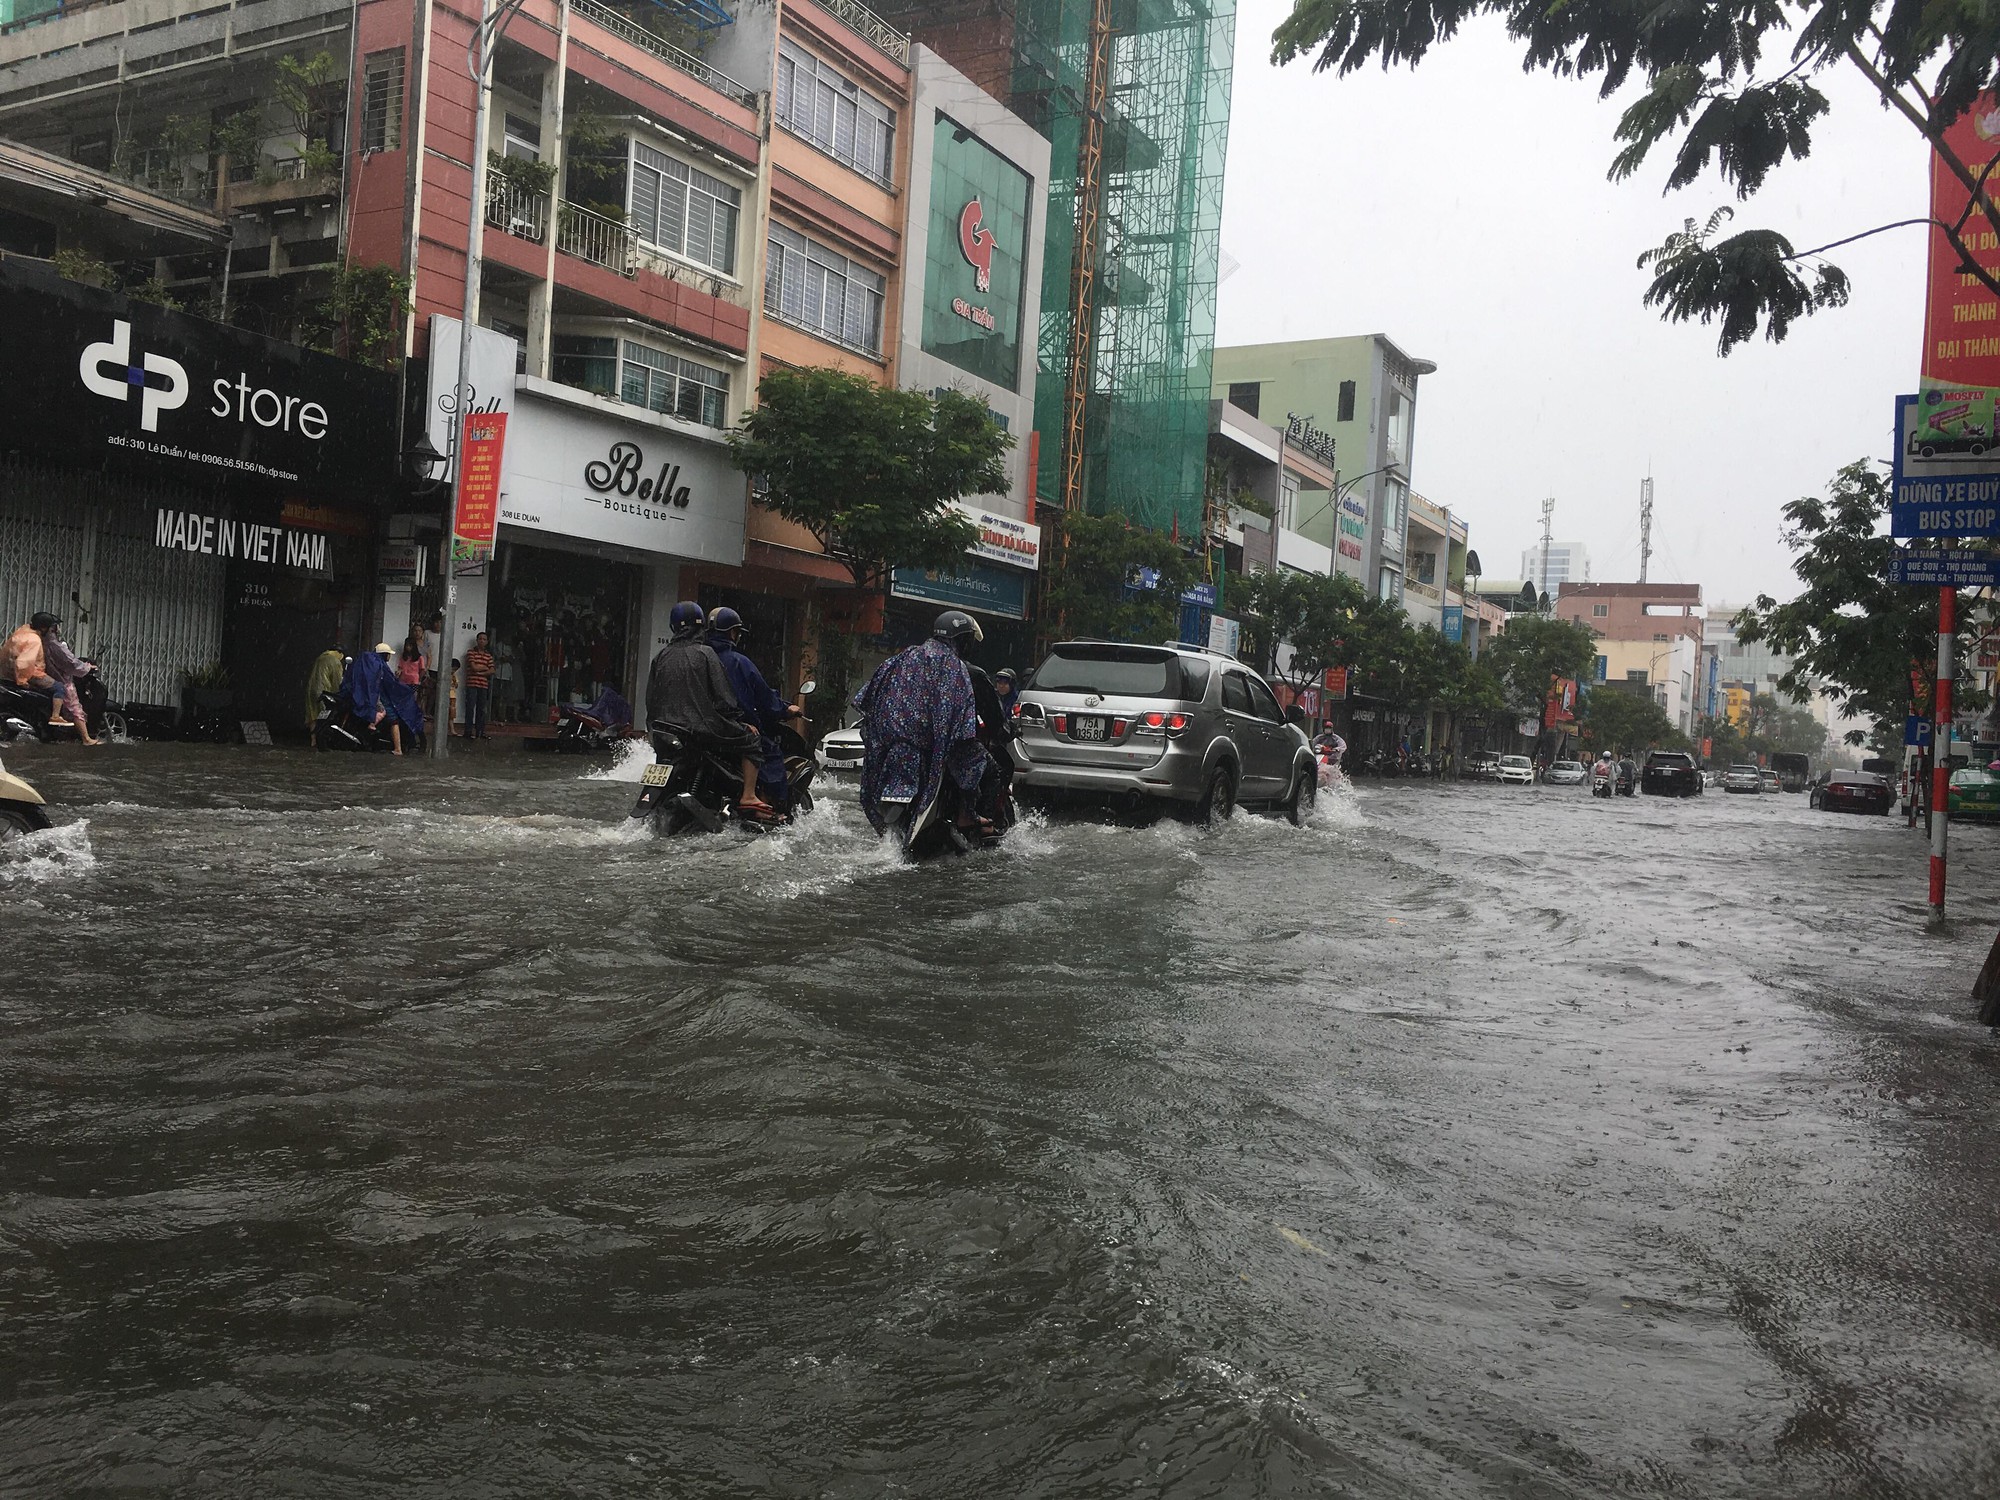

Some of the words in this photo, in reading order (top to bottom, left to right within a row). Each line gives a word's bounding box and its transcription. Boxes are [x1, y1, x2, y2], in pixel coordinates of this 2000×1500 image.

[1980, 231, 2000, 250] ĐO
[953, 298, 971, 319] GIA
[1953, 301, 1997, 322] THÀNH
[1938, 340, 1960, 363] ĐẠI
[211, 372, 328, 439] store
[1944, 391, 1985, 402] MOSFLY
[130, 438, 145, 450] 310
[585, 441, 691, 509] Bella
[1899, 481, 1941, 503] DỪNG
[1945, 483, 1966, 502] XE
[501, 510, 513, 519] 308
[604, 498, 667, 520] Boutique
[1919, 510, 1951, 530] BUS
[1954, 509, 1996, 528] STOP
[155, 508, 214, 554] MADE
[217, 518, 236, 557] IN
[242, 523, 282, 563] VIET
[286, 531, 325, 570] NAM
[1961, 563, 1987, 571] QUANG
[1889, 573, 1898, 581] 12
[1937, 573, 1947, 581] SA
[1969, 574, 1994, 583] QUANG
[245, 583, 268, 595] 310
[462, 622, 477, 631] 308
[1083, 717, 1099, 729] 75A
[1916, 723, 1930, 742] P
